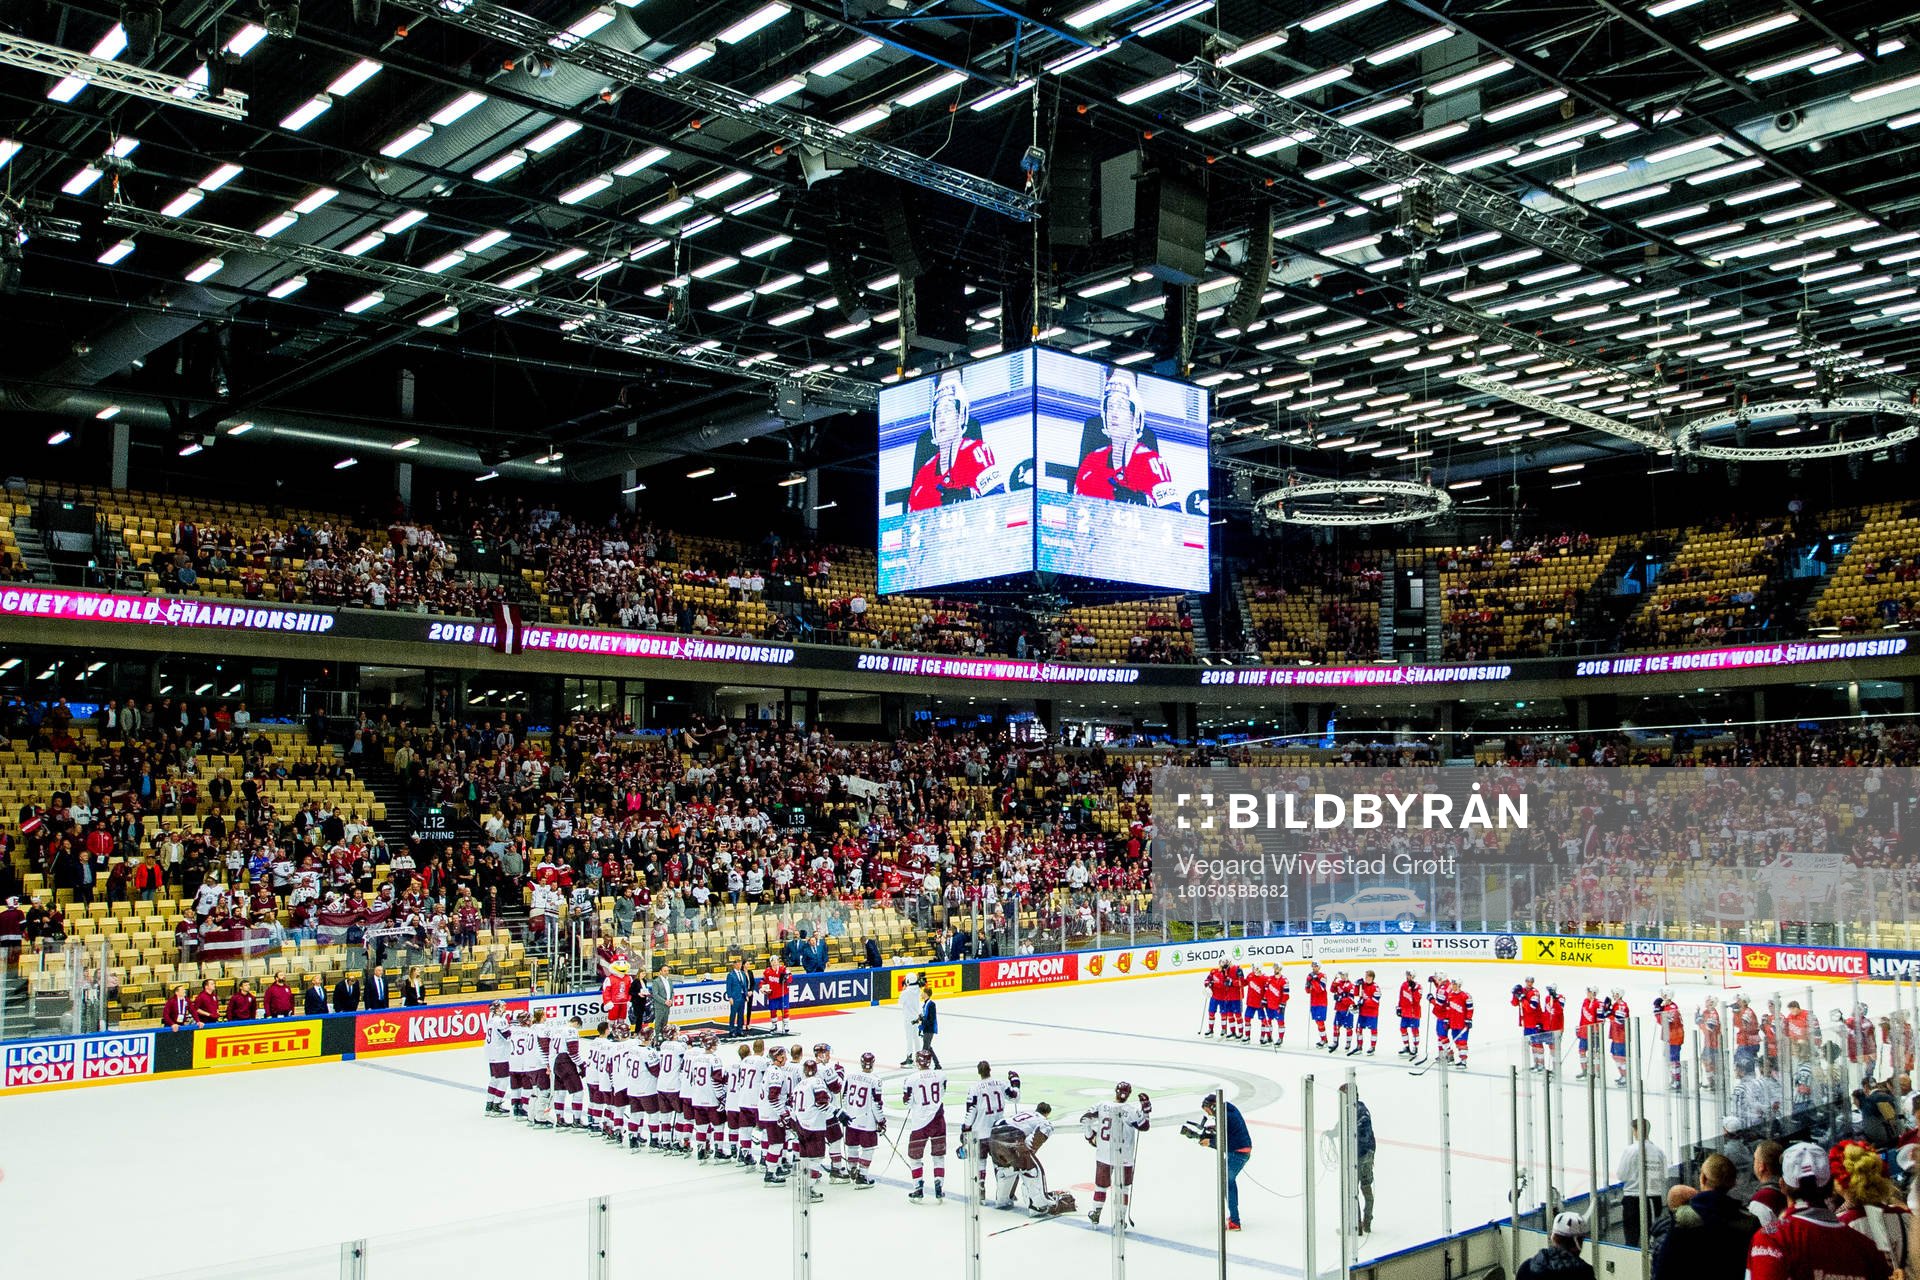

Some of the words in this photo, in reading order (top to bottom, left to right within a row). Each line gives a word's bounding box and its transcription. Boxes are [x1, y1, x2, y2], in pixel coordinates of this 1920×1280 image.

[76, 597, 158, 620] WORLD
[166, 604, 334, 632] CHAMPIONSHIP
[429, 623, 475, 642] 2018
[522, 630, 551, 648] ICE
[555, 633, 622, 652] HOCKEY
[626, 638, 678, 655] WORLD
[684, 642, 795, 663] CHAMPIONSHIP
[1577, 661, 1609, 675] 2018
[1613, 659, 1642, 674] IIHF
[1646, 657, 1669, 672] ICE
[1672, 653, 1728, 670] HOCKEY
[1731, 649, 1783, 666] WORLD
[1787, 639, 1907, 663] CHAMPIONSHIP
[858, 655, 888, 670] 2018
[892, 657, 917, 672] IIHF
[921, 659, 942, 674] ICE
[944, 661, 992, 677] HOCKEY
[995, 664, 1037, 679] WORLD
[1041, 666, 1139, 683] CHAMPIONSHIP
[1201, 670, 1234, 684] 2018
[1238, 671, 1266, 684] IIHF
[1270, 670, 1292, 684] ICE
[1296, 669, 1351, 684] HOCKEY
[1354, 668, 1401, 683] WORLD
[1406, 665, 1511, 683] CHAMPIONSHIP
[423, 816, 445, 828] L12
[788, 814, 805, 824] L13
[419, 831, 455, 840] ERNING
[1248, 944, 1294, 956] ŠKODA
[1434, 938, 1489, 948] TISSOT
[1559, 938, 1614, 951] Raiffeisen
[1632, 942, 1662, 954] LIQUI
[1187, 949, 1225, 961] ŠKODA
[1560, 951, 1593, 963] BANK
[1632, 953, 1663, 966] MOLY
[1776, 951, 1864, 974] KRUŠOVICE
[998, 958, 1064, 980] PATRON
[686, 991, 730, 1005] TISS
[820, 979, 868, 1000] MEN
[560, 1002, 608, 1017] TISS
[85, 1037, 148, 1059] LIQUI
[205, 1028, 311, 1059] PIRELLI
[10, 1043, 73, 1066] LIQUI
[8, 1062, 74, 1085] MOLY
[84, 1055, 148, 1078] MOLY
[848, 1084, 868, 1108] 29
[919, 1082, 940, 1106] 18
[982, 1091, 1003, 1115] 11
